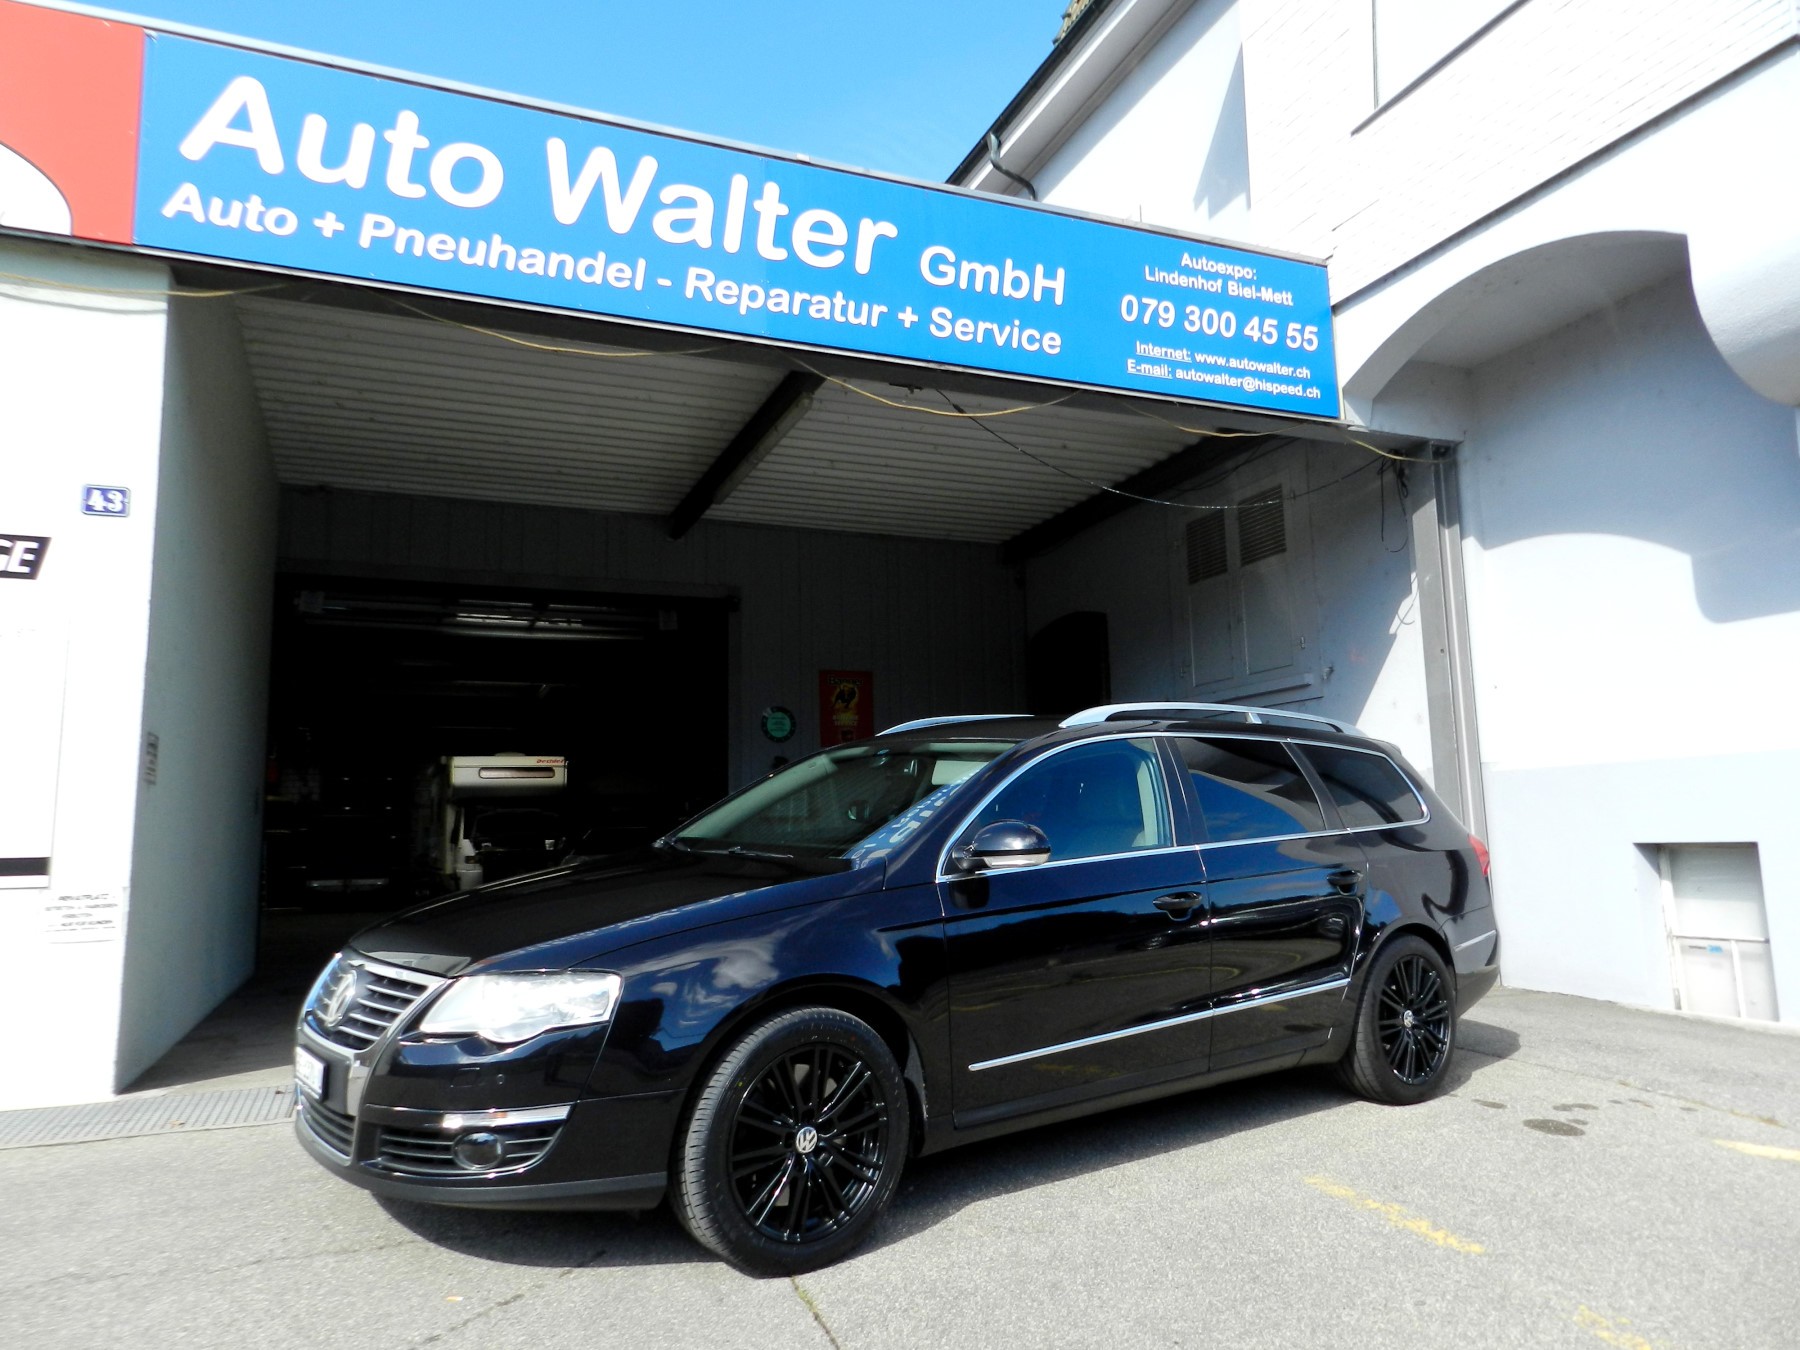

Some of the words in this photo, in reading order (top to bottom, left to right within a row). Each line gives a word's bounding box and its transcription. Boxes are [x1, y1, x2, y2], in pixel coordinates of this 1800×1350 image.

[178, 75, 505, 209] Auto
[545, 136, 899, 275] Walter
[919, 245, 1066, 306] GmbH
[160, 182, 299, 237] Auto
[312, 210, 346, 239] +
[357, 212, 647, 292] Pneuhandel
[684, 266, 890, 328] Reparatur
[897, 305, 919, 329] +
[929, 306, 1062, 355] Service
[1144, 265, 1223, 294] Lindenhof
[1227, 280, 1294, 306] Biel-Mett
[1180, 252, 1257, 281] Autoexpo:
[1120, 294, 1176, 328] 079
[1183, 304, 1237, 339] 300
[1243, 316, 1279, 345] 45
[1285, 322, 1319, 352] 55
[1127, 358, 1173, 380] E-mail:
[1175, 369, 1321, 399] autowalter@hispeed.ch
[1135, 340, 1192, 363] Internet:
[1194, 353, 1311, 379] www.autowalter.ch
[87, 488, 124, 513] 43
